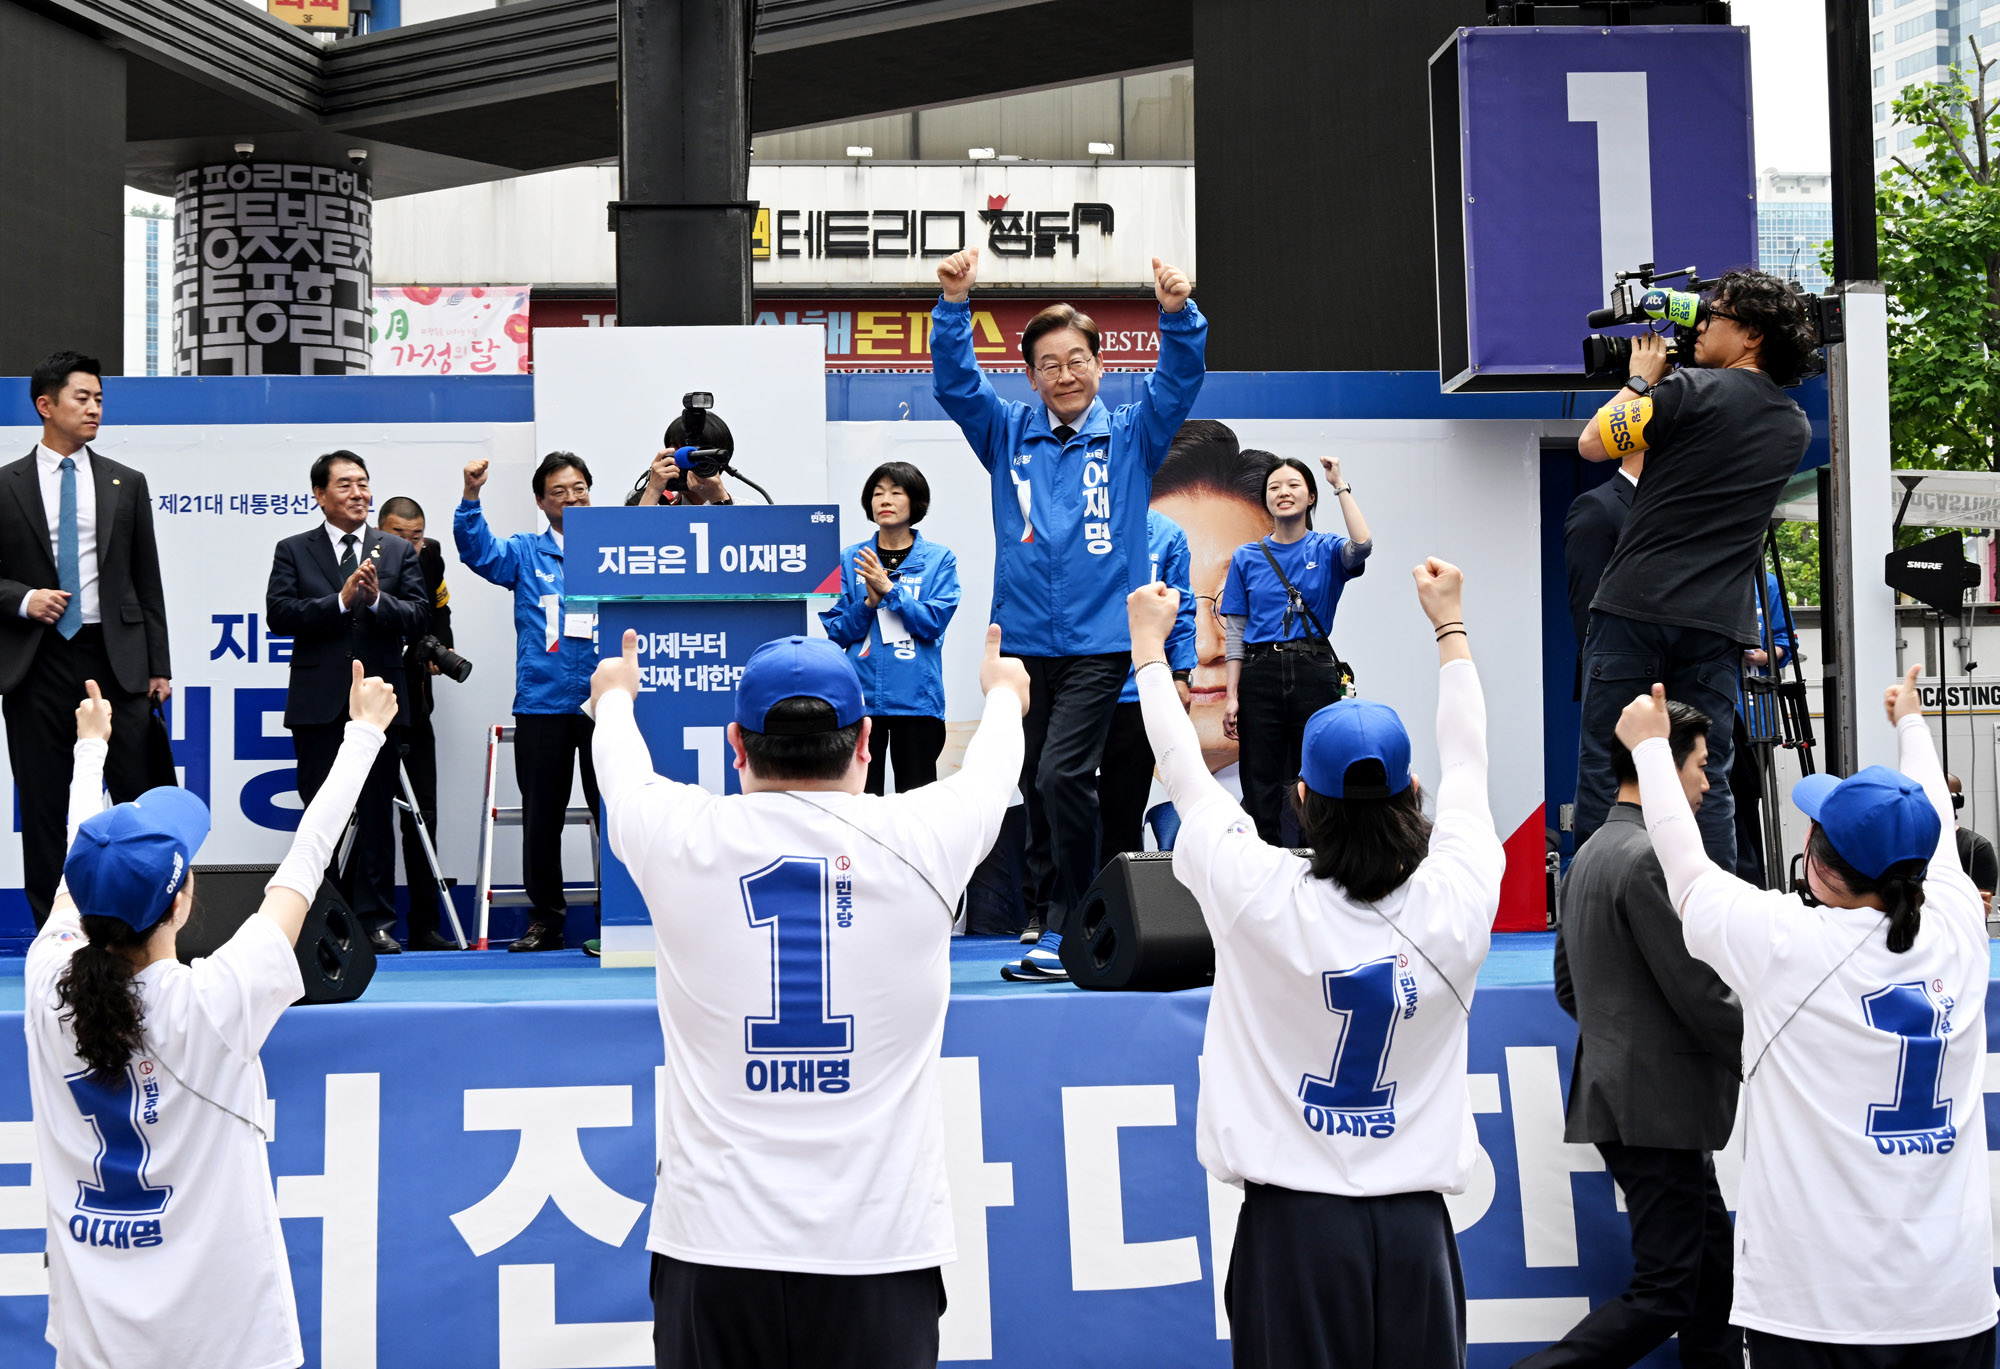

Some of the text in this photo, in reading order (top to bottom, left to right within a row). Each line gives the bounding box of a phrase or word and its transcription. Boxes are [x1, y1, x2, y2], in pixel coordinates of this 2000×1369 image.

[303, 14, 313, 23] 3F
[1566, 71, 1656, 324] 1
[470, 338, 501, 373] 달
[1609, 403, 1636, 452] PRESS
[158, 493, 224, 516] 제21대
[598, 522, 807, 575] 지금은 1 이재명
[1906, 560, 1944, 571] SHURE
[637, 632, 727, 660] 이제부터
[638, 665, 682, 693] 진짜
[683, 726, 726, 796] 1
[835, 880, 854, 928] 민주당
[739, 854, 855, 1055] 1
[1298, 955, 1398, 1113] 1
[745, 1058, 850, 1094] 이재명
[1861, 980, 1953, 1137] 1
[143, 1081, 160, 1125] 민주당
[1303, 1104, 1396, 1139] 이재명
[63, 1062, 174, 1217] 1
[68, 1214, 164, 1250] 이재명
